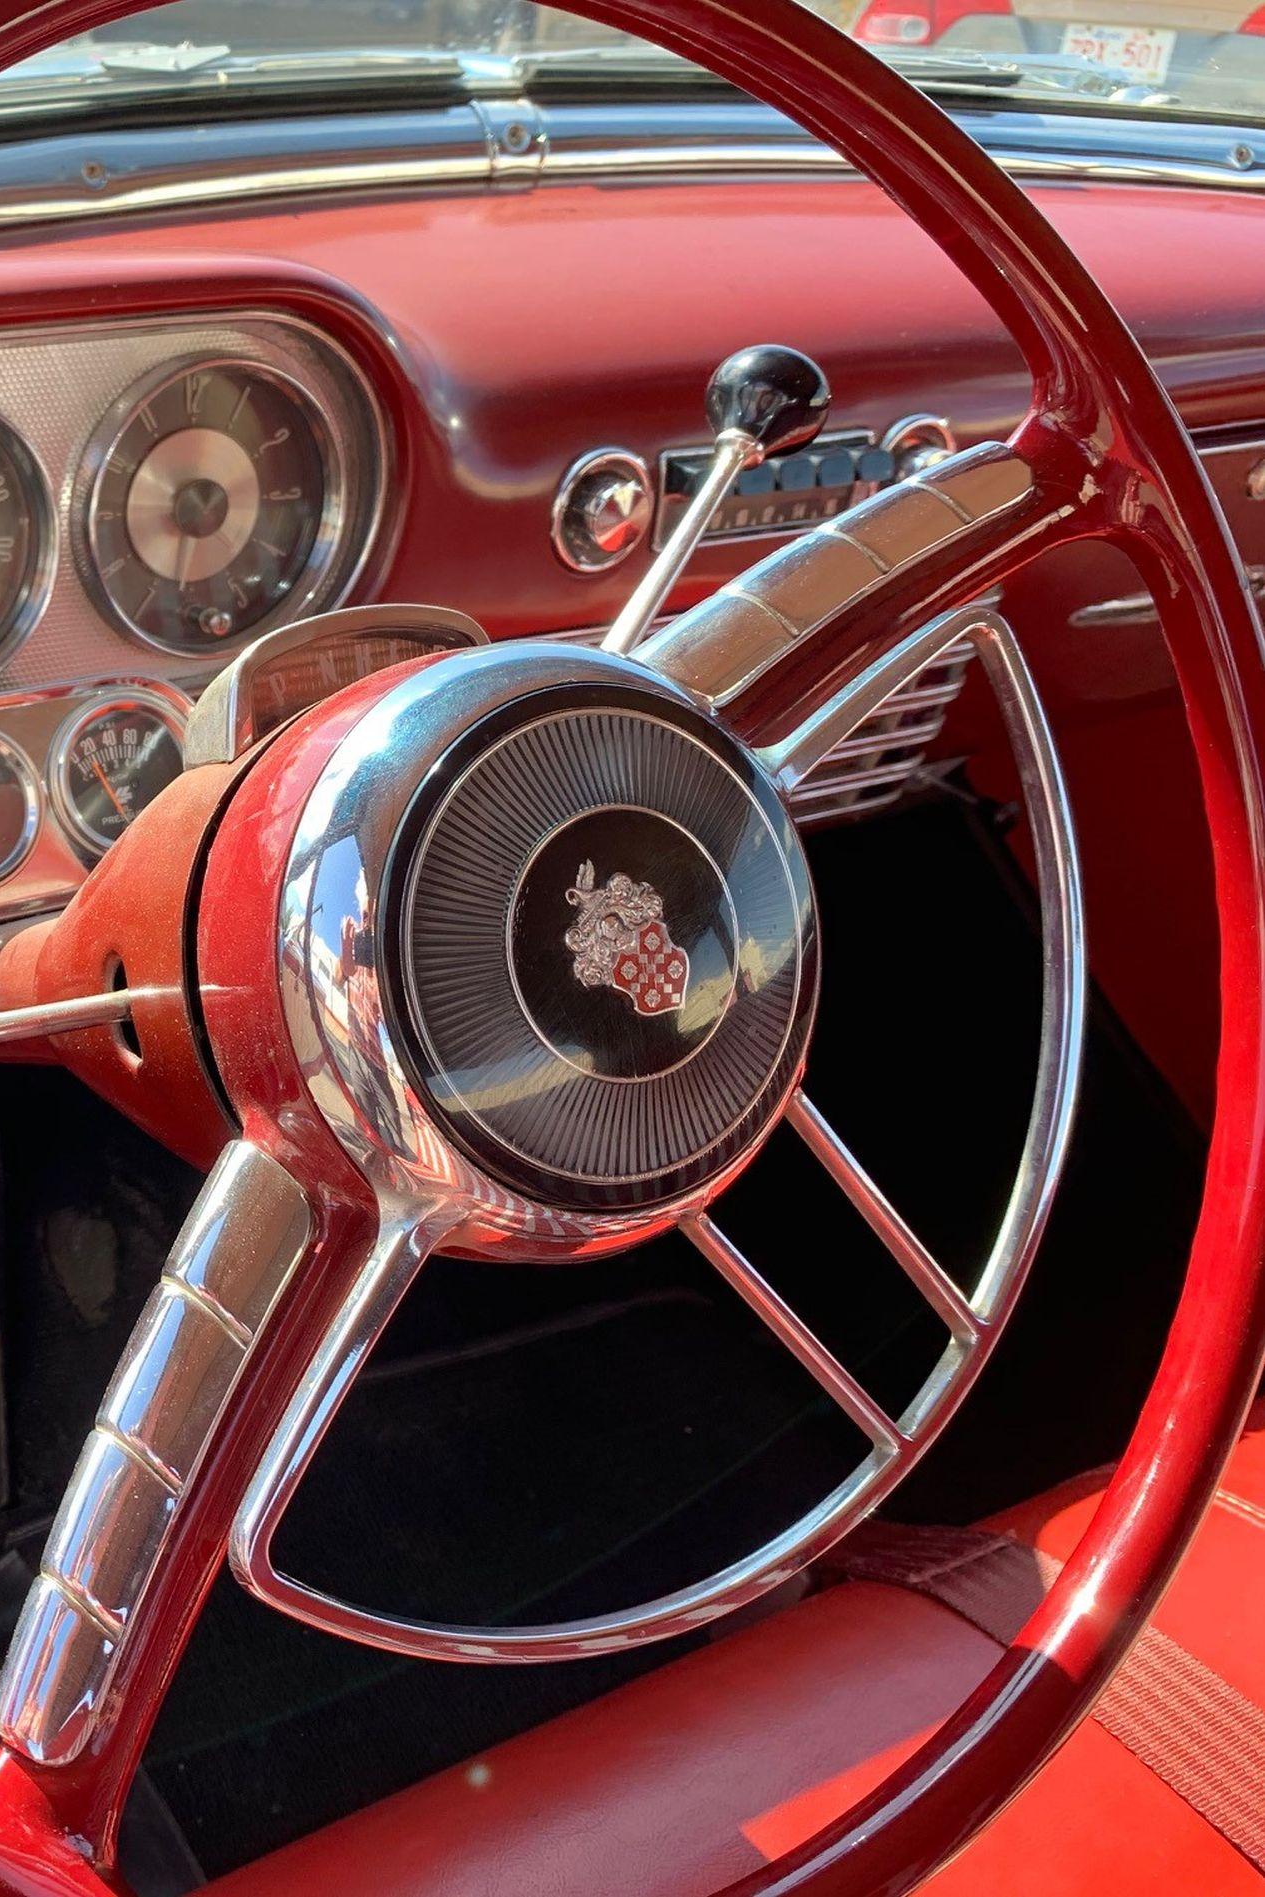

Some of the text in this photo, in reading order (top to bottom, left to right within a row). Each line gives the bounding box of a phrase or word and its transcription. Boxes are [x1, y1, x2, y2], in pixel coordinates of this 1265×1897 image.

[258, 427, 291, 453] 2
[79, 736, 96, 757] 20
[102, 729, 116, 747] 40
[122, 728, 138, 745] 60
